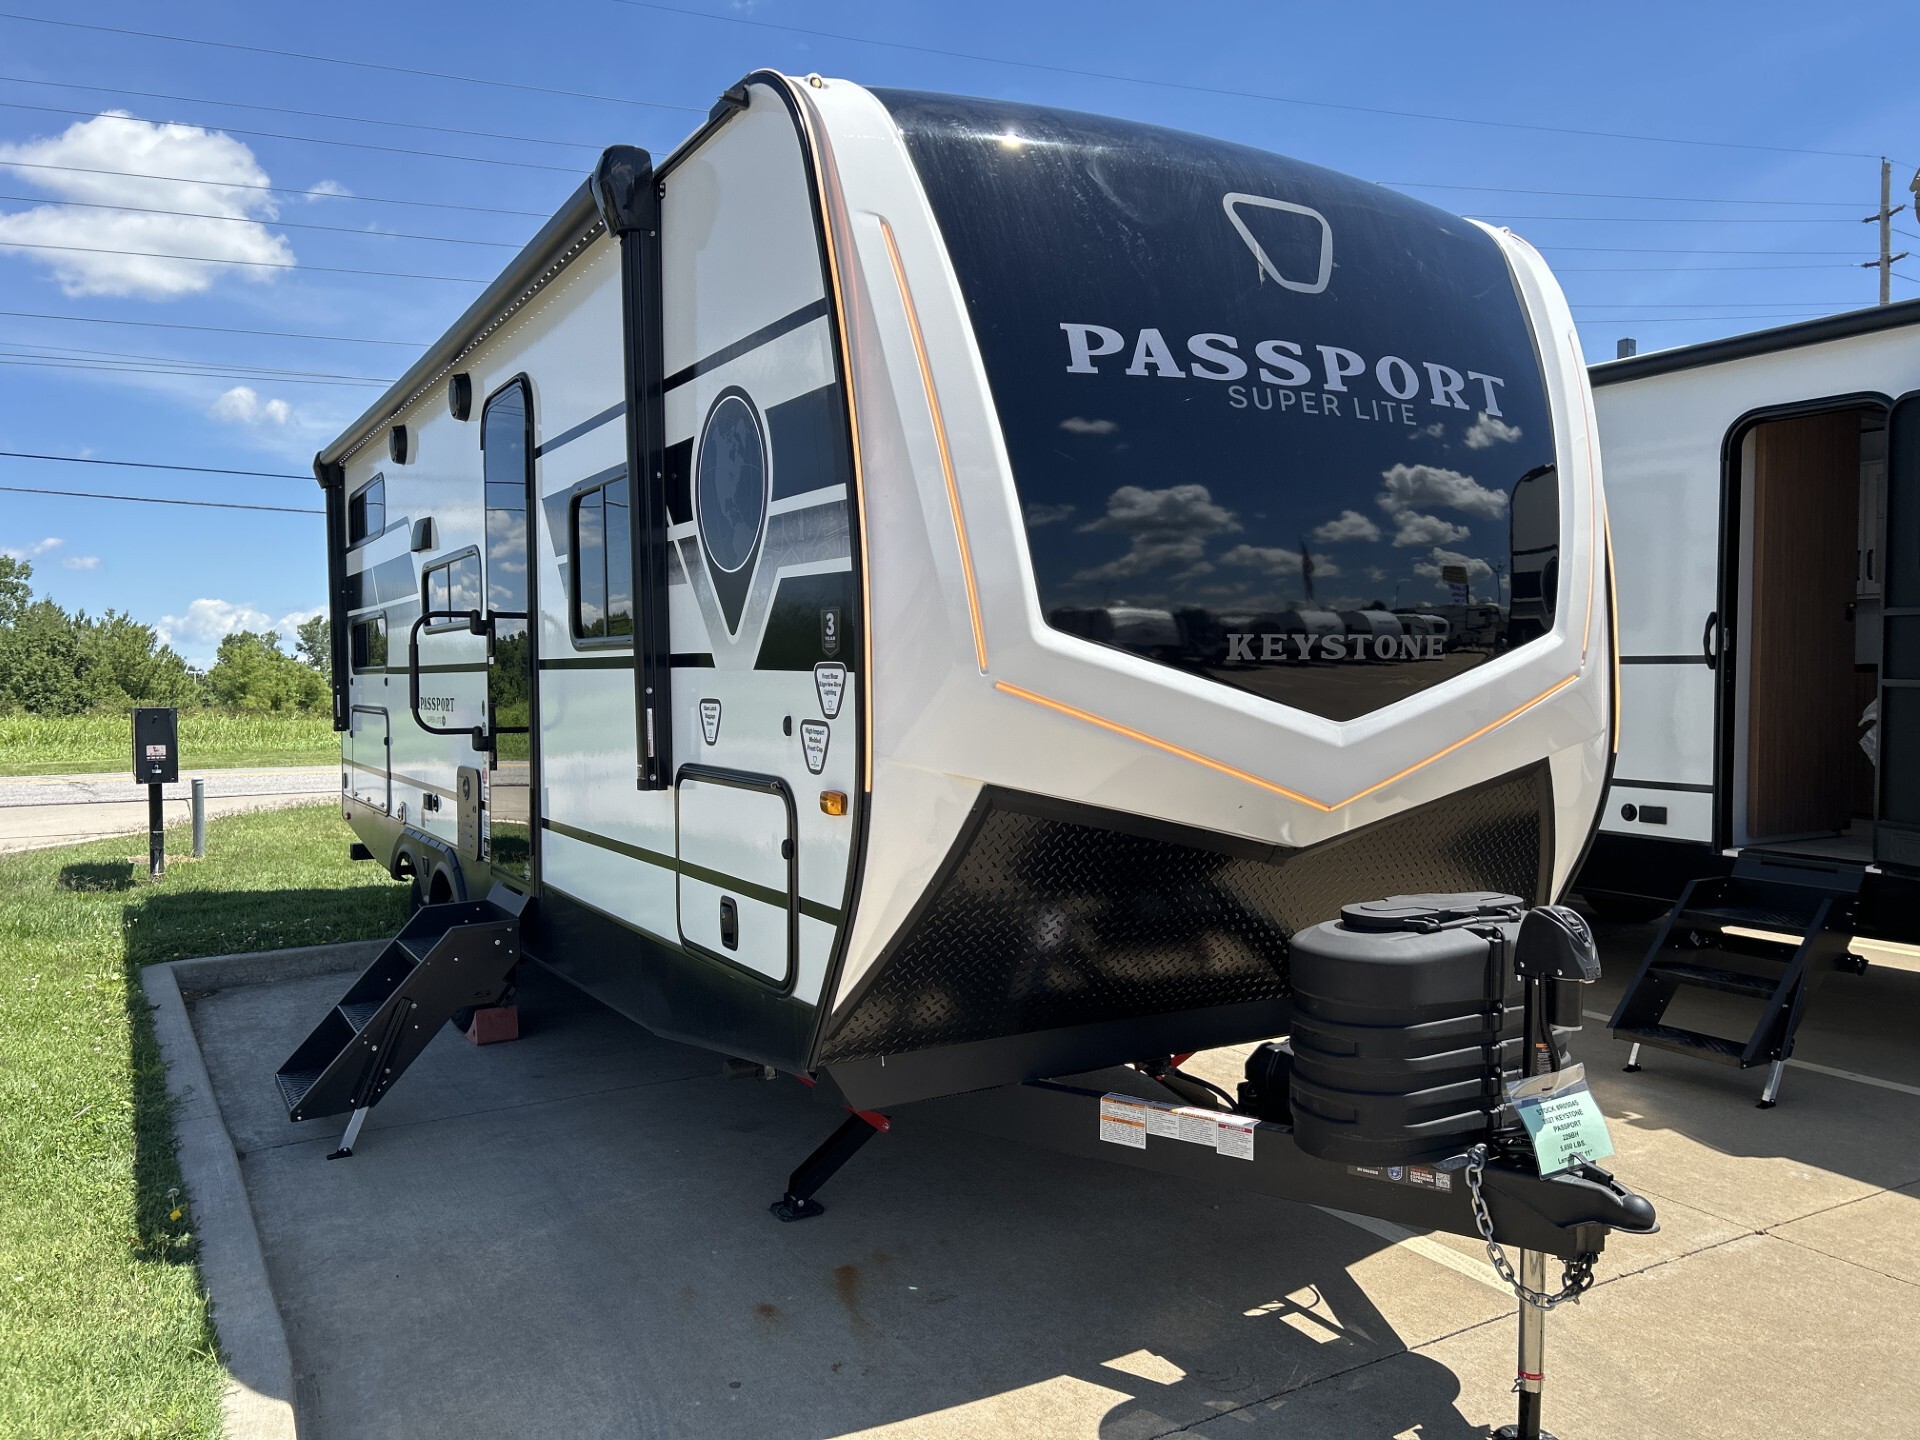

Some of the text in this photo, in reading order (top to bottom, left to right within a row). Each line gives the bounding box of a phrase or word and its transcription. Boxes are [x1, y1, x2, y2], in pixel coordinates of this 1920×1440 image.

[1059, 322, 1505, 418] PASSPORT
[1228, 385, 1418, 426] SUPER LITE
[826, 612, 835, 635] 3
[1226, 633, 1447, 661] KEYSTONE
[420, 696, 455, 712] PASSPORT
[1536, 1105, 1556, 1115] STOCK
[1554, 1109, 1584, 1122] KEYSTONE
[1553, 1119, 1582, 1132] PASSPORT
